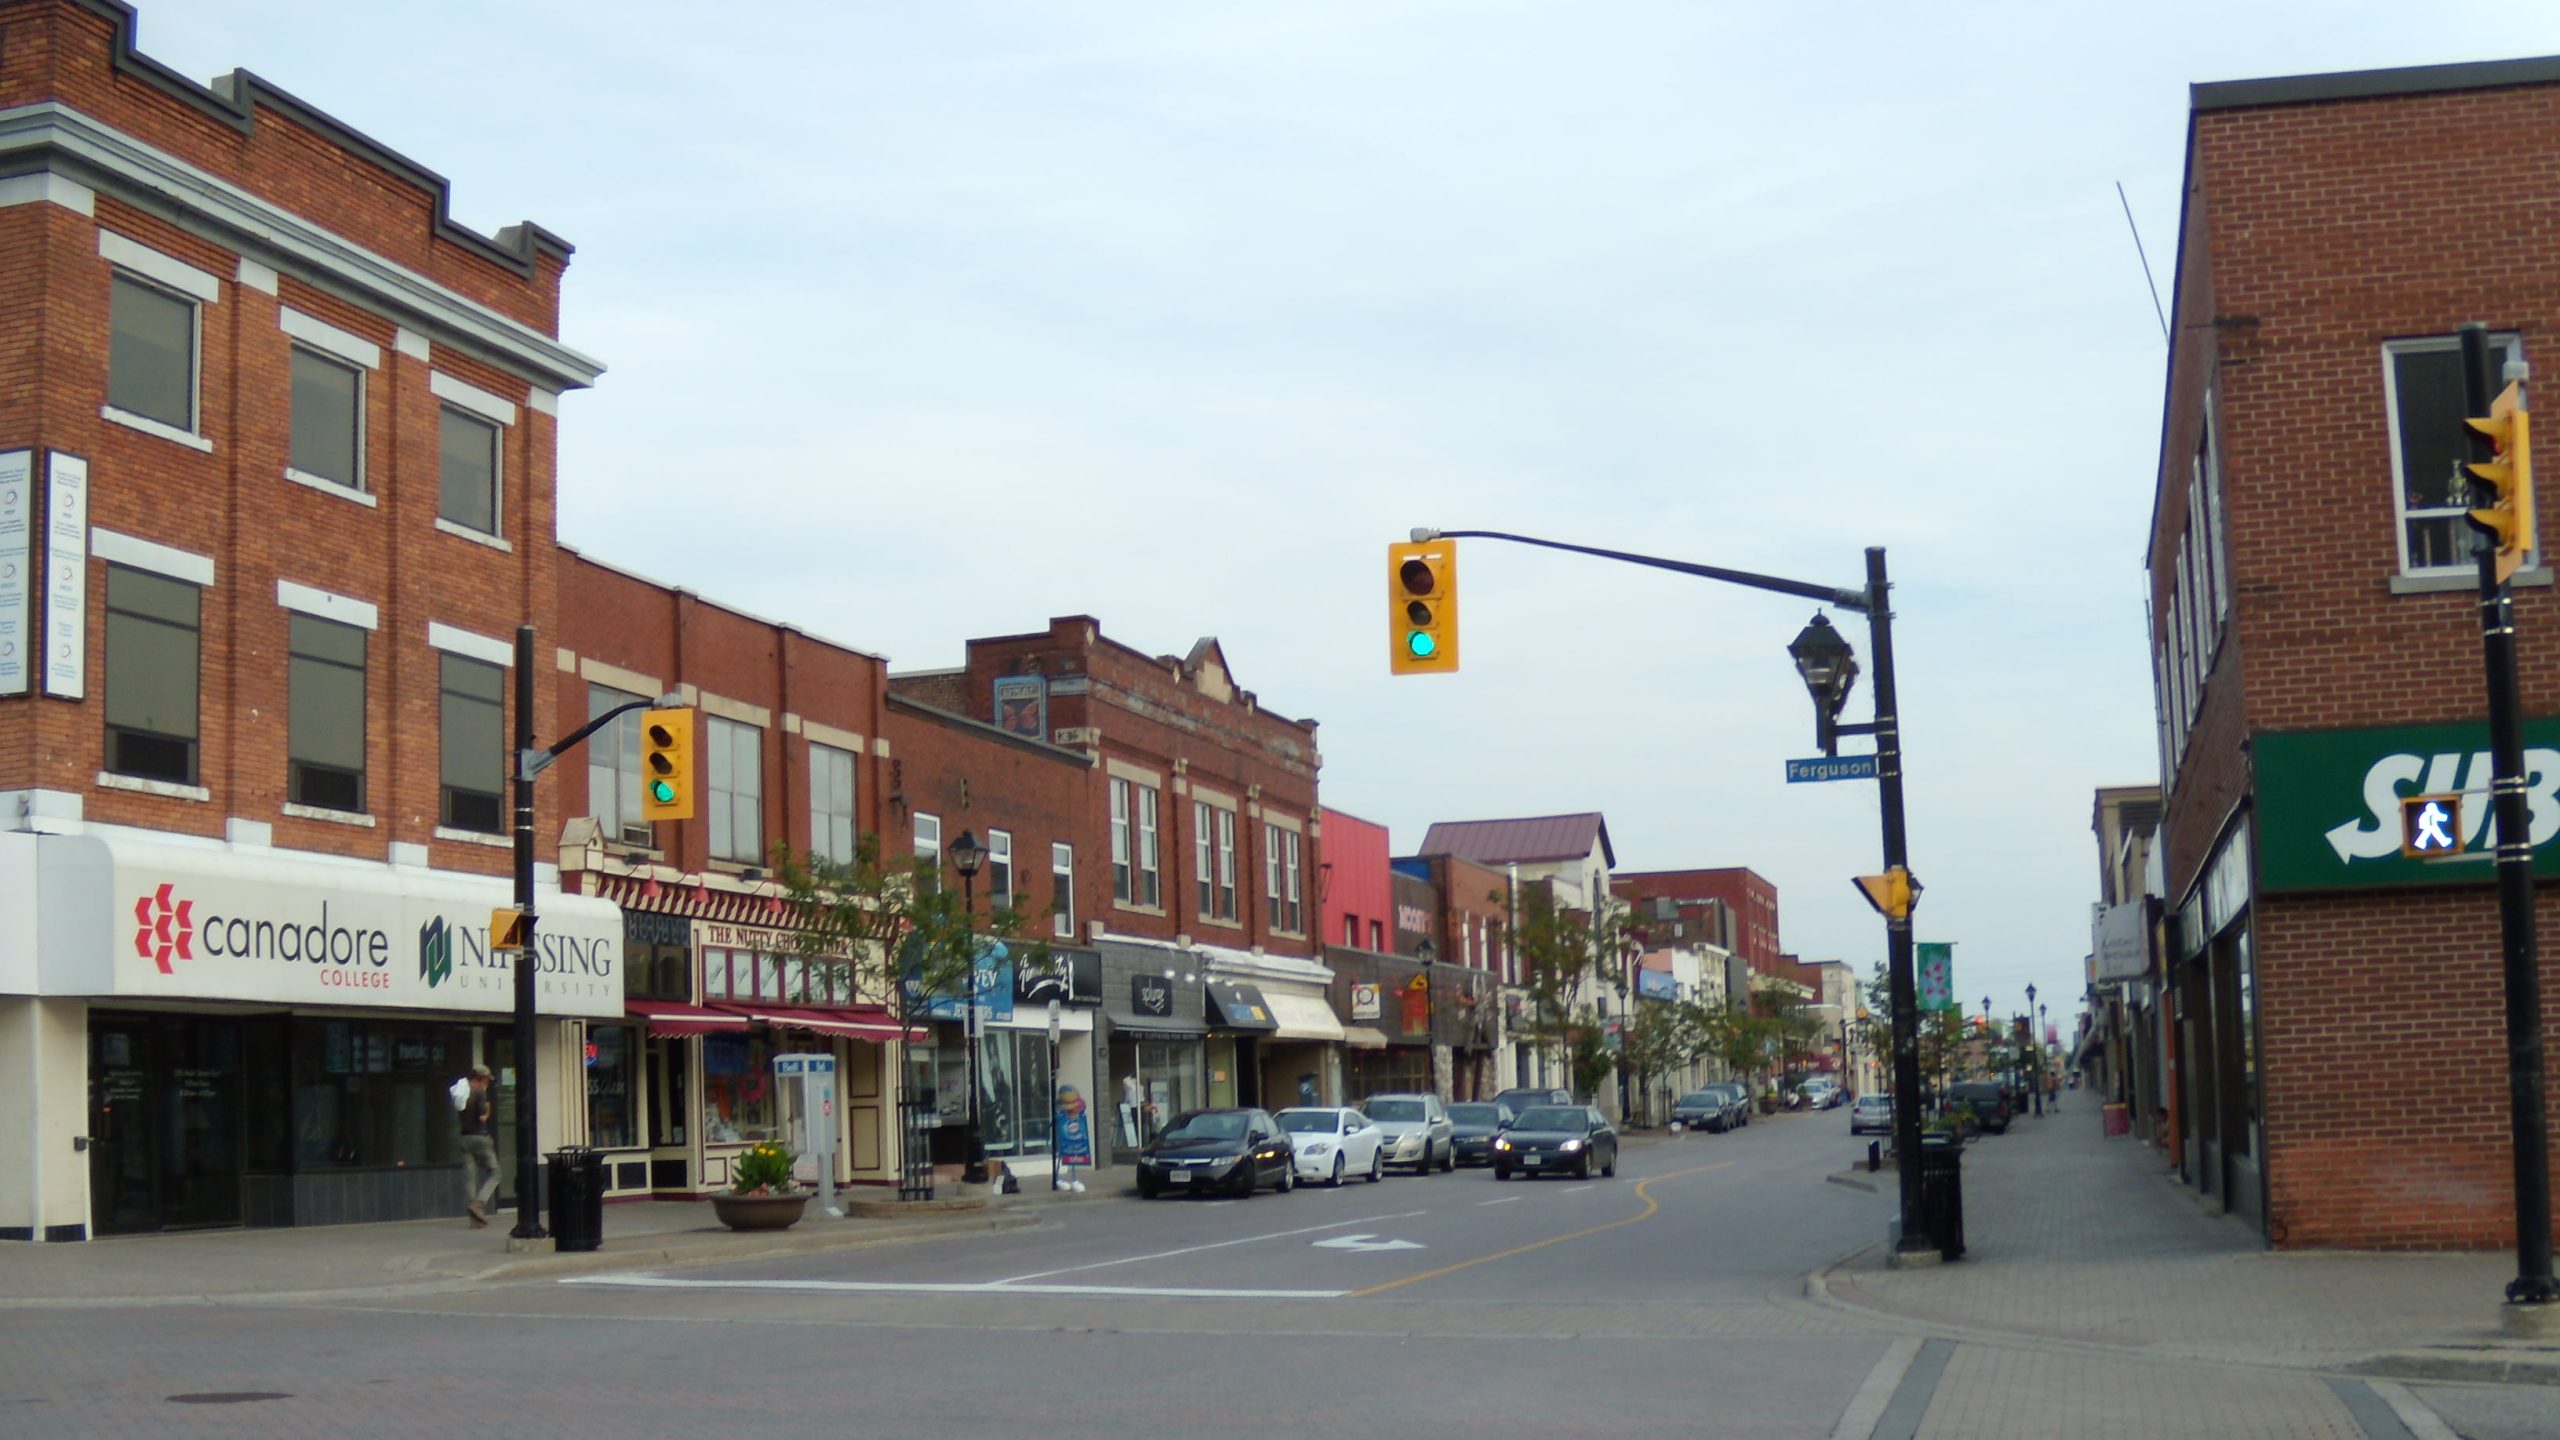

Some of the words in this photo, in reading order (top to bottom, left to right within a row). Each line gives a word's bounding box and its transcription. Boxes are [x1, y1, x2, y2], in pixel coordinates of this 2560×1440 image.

[1789, 761, 1872, 780] Ferguson
[203, 899, 389, 967] canadore
[708, 924, 732, 944] THE
[736, 929, 773, 950] NUTTY
[459, 926, 612, 977] NSSING
[320, 969, 390, 989] COLLEGE
[459, 975, 611, 997] UNIRSITY
